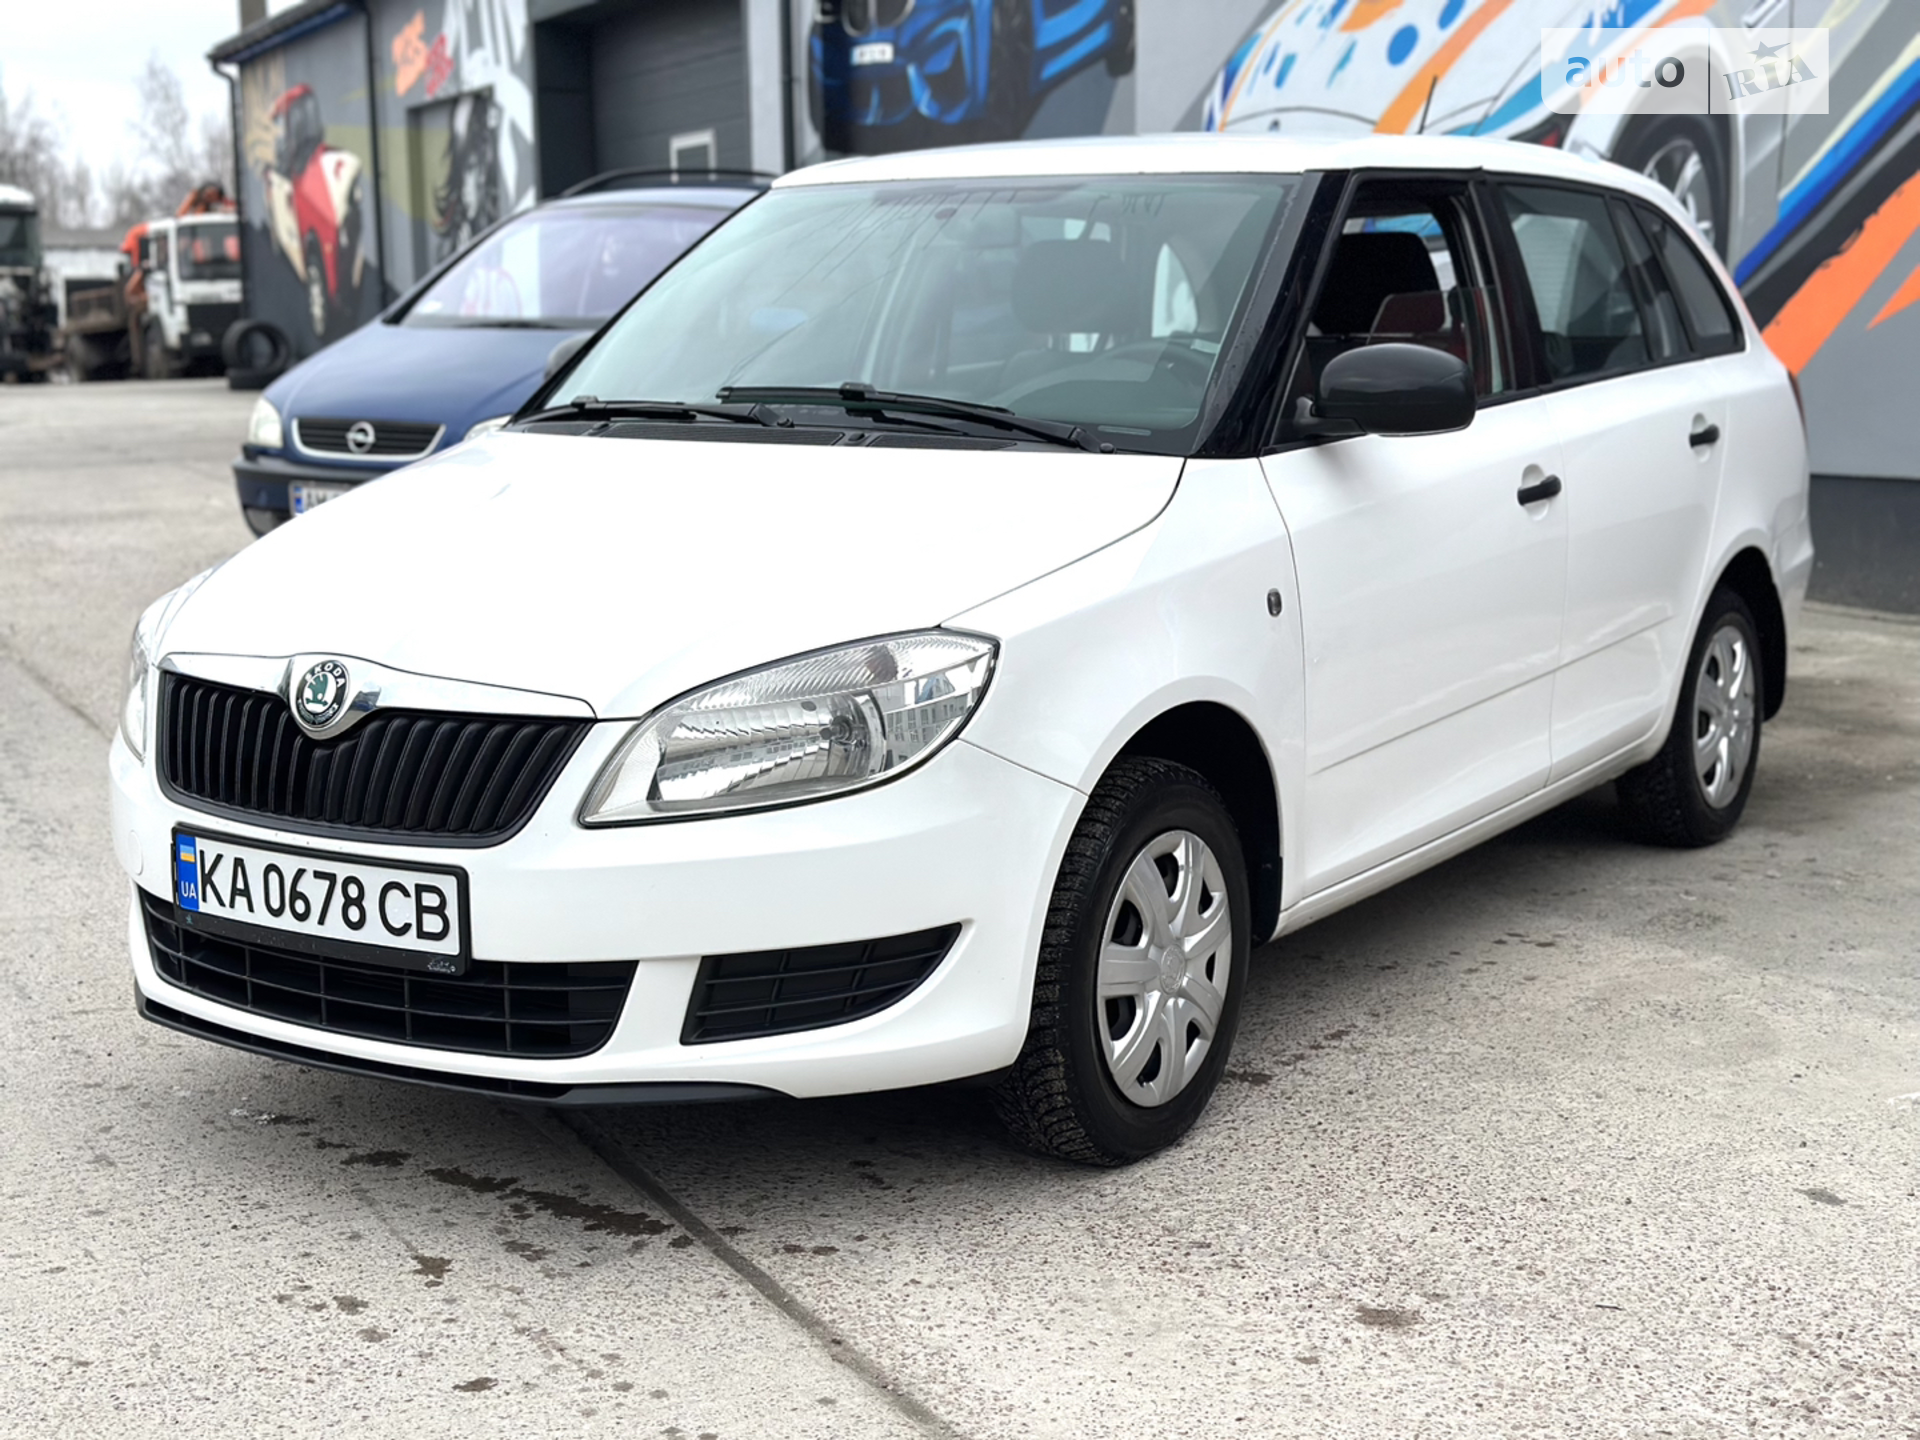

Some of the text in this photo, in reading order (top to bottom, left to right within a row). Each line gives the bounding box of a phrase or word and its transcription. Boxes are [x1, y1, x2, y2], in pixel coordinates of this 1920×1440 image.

[180, 849, 451, 942] UA KA 0678 CB
